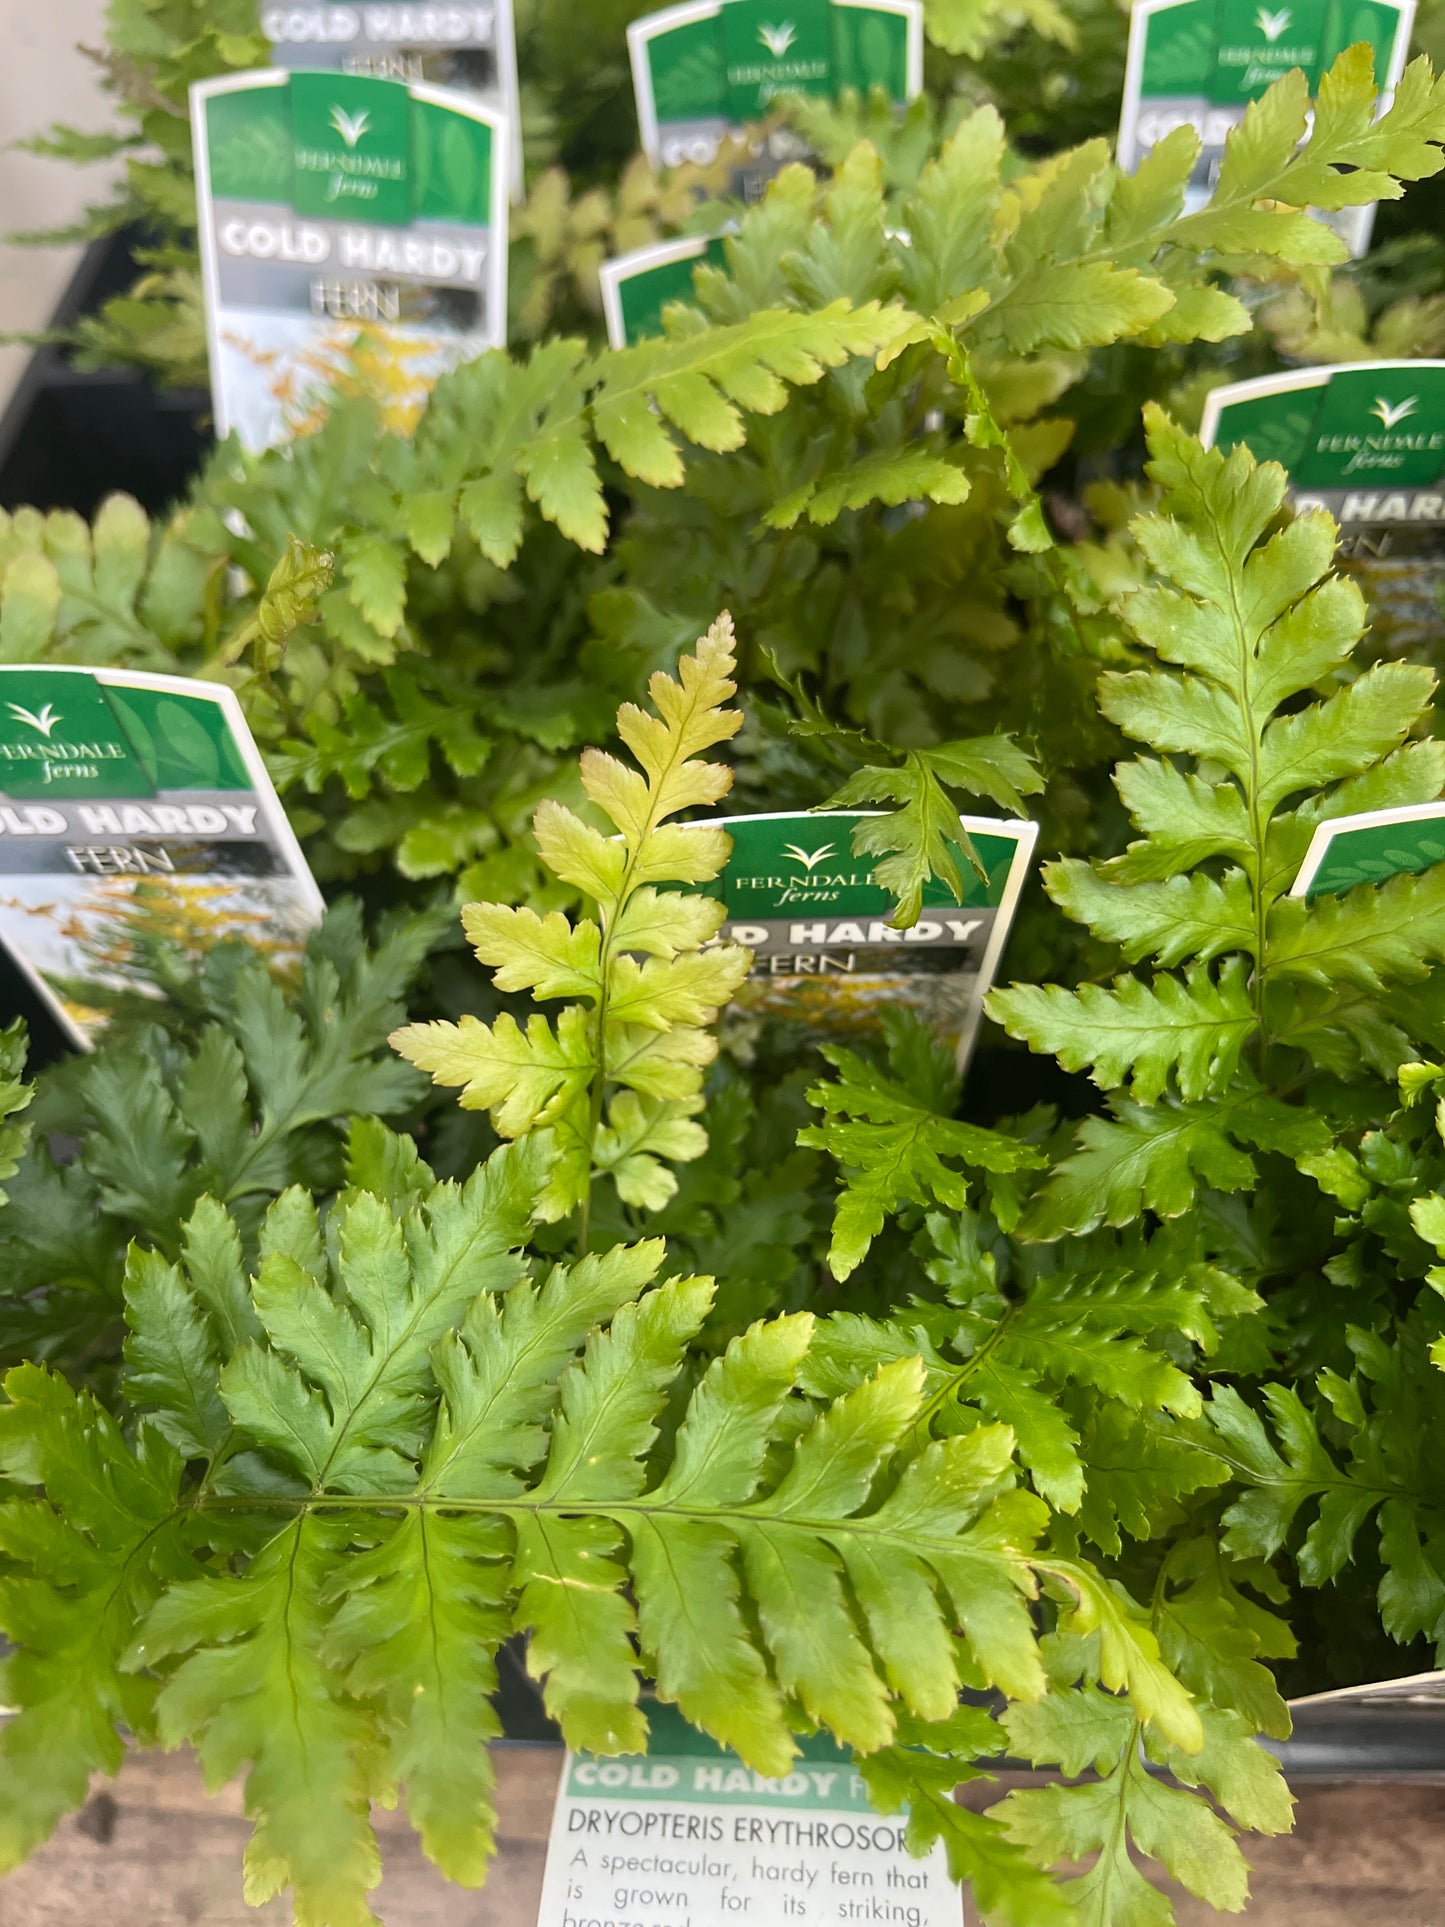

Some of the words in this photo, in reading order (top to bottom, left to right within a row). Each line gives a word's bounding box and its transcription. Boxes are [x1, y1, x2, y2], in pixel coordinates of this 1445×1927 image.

[261, 5, 360, 43] COLD
[364, 5, 496, 42] HARDY
[219, 218, 332, 264] COLD
[340, 230, 487, 282] HARDY
[310, 278, 400, 322] FERN
[1340, 491, 1445, 522] HAR
[0, 742, 126, 760] ERNDALE
[42, 758, 98, 785] ferns
[77, 804, 258, 835] HARDY
[65, 845, 175, 875] FERN
[736, 874, 876, 889] FERNDALE
[773, 886, 840, 907] ferns
[789, 920, 983, 944] HARDY
[574, 1761, 680, 1789] COLD
[693, 1766, 838, 1798] HARDY
[568, 1808, 724, 1841] DRYOPTERIS
[733, 1816, 911, 1852] ERYTHROSOR
[569, 1848, 588, 1868] A
[600, 1853, 738, 1881] spectacular,
[751, 1856, 818, 1890] hardy
[830, 1861, 874, 1886] fern
[887, 1865, 928, 1889] that
[567, 1879, 583, 1899] is
[614, 1888, 688, 1909] grown
[721, 1886, 751, 1911] for
[784, 1894, 806, 1916] its
[839, 1896, 928, 1927] striking,
